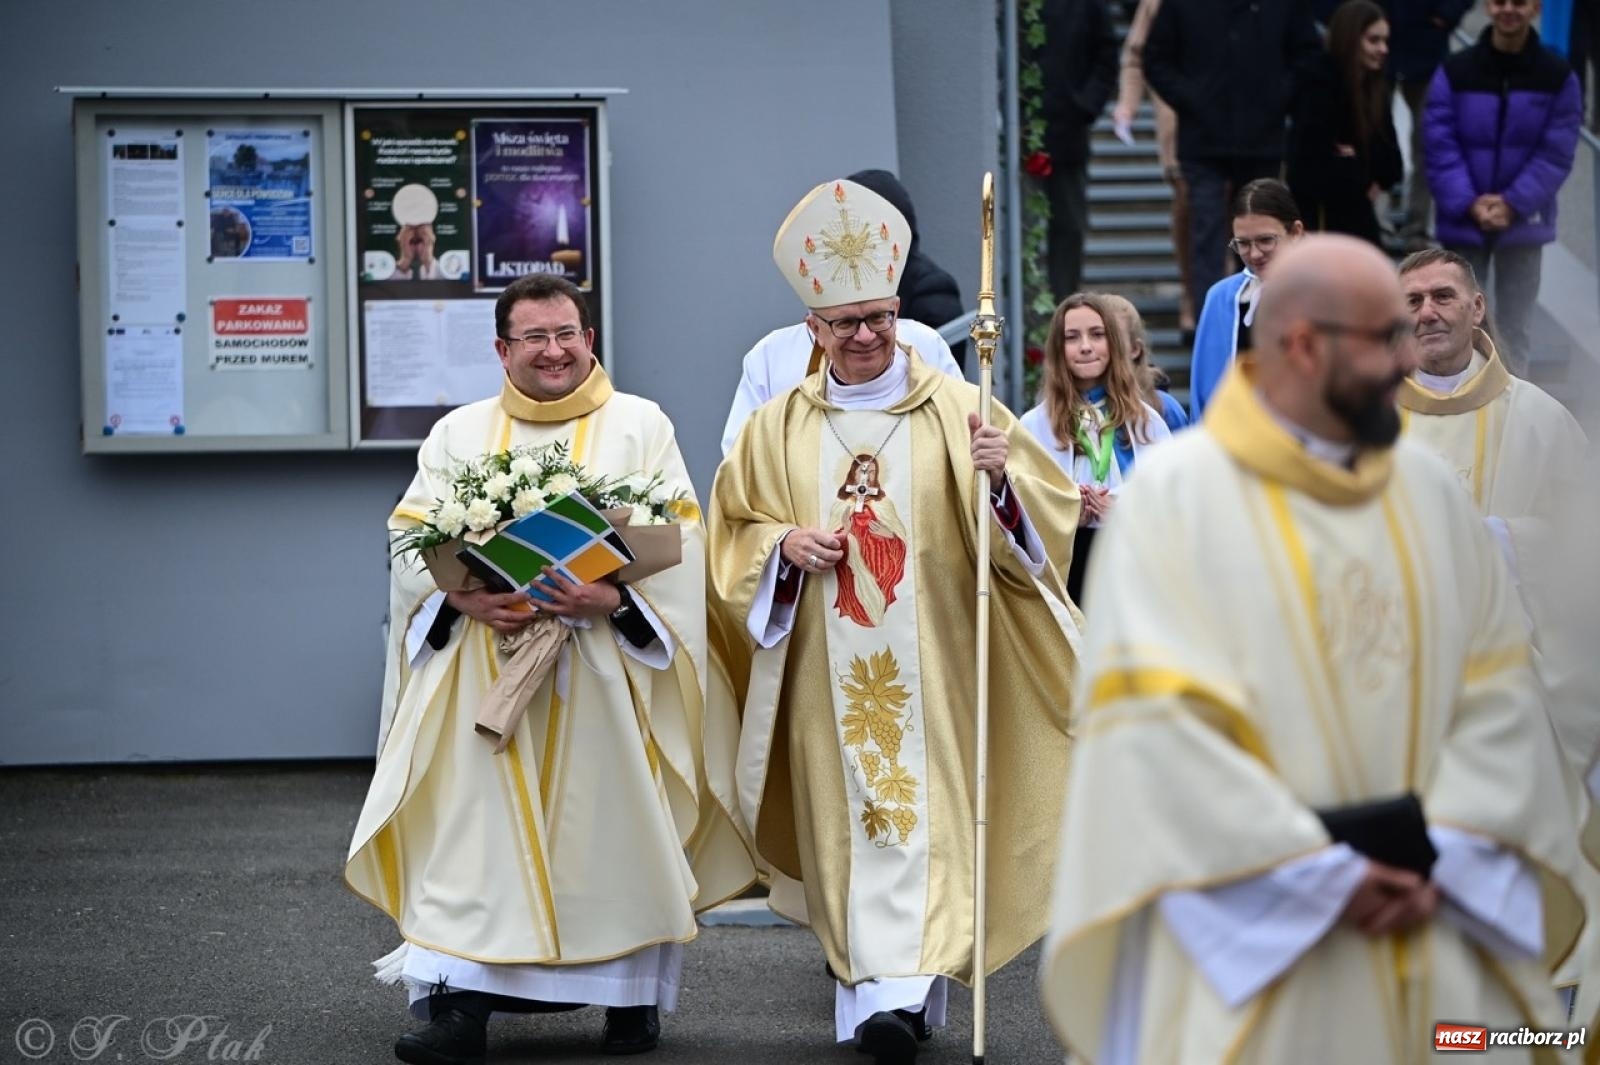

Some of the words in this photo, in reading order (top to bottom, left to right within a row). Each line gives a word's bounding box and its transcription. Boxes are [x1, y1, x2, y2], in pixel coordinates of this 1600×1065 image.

[237, 303, 283, 316] ZAKAZ
[216, 319, 305, 331] PARKOWANIA
[215, 338, 308, 348] SAMOCHODÓW
[215, 355, 256, 364] PRZED
[262, 354, 308, 363] MUREM
